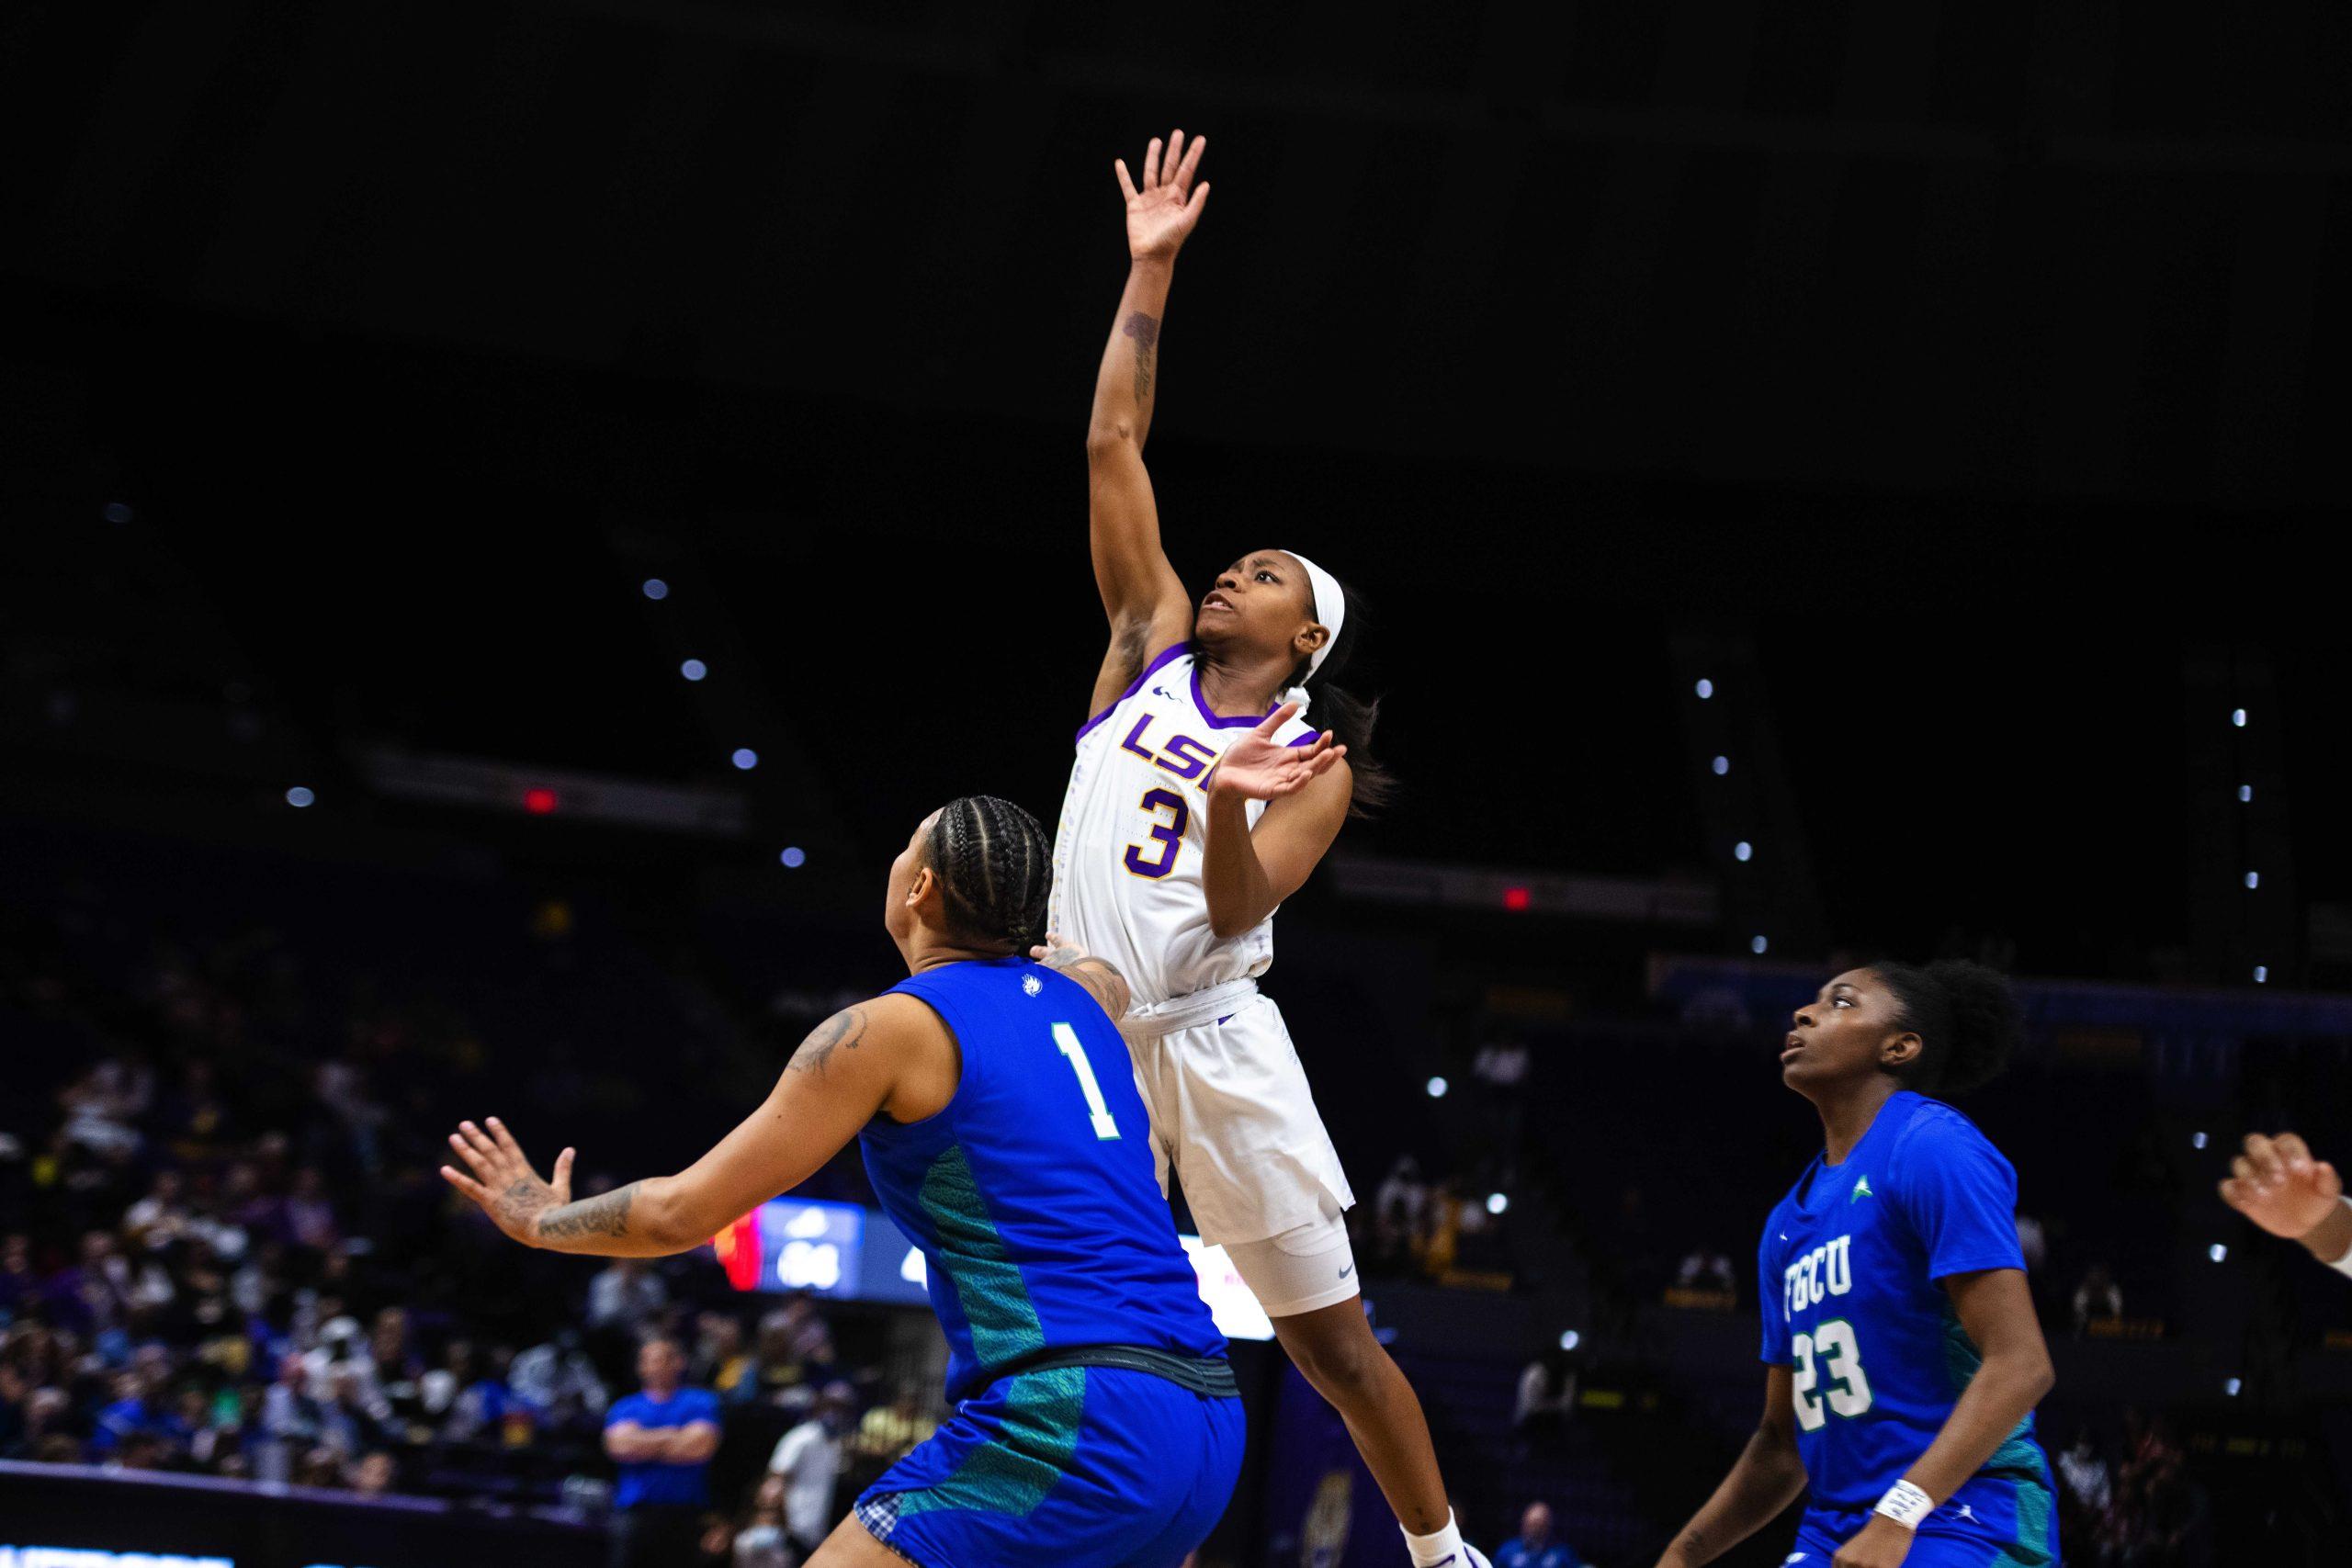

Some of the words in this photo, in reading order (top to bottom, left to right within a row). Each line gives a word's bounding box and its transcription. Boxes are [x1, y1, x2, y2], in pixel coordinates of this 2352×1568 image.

[1121, 713, 1222, 793] LS
[1124, 787, 1191, 881] 3
[1051, 1022, 1122, 1140] 1
[1784, 1235, 1851, 1323] FGCU
[1792, 1317, 1873, 1431] 23
